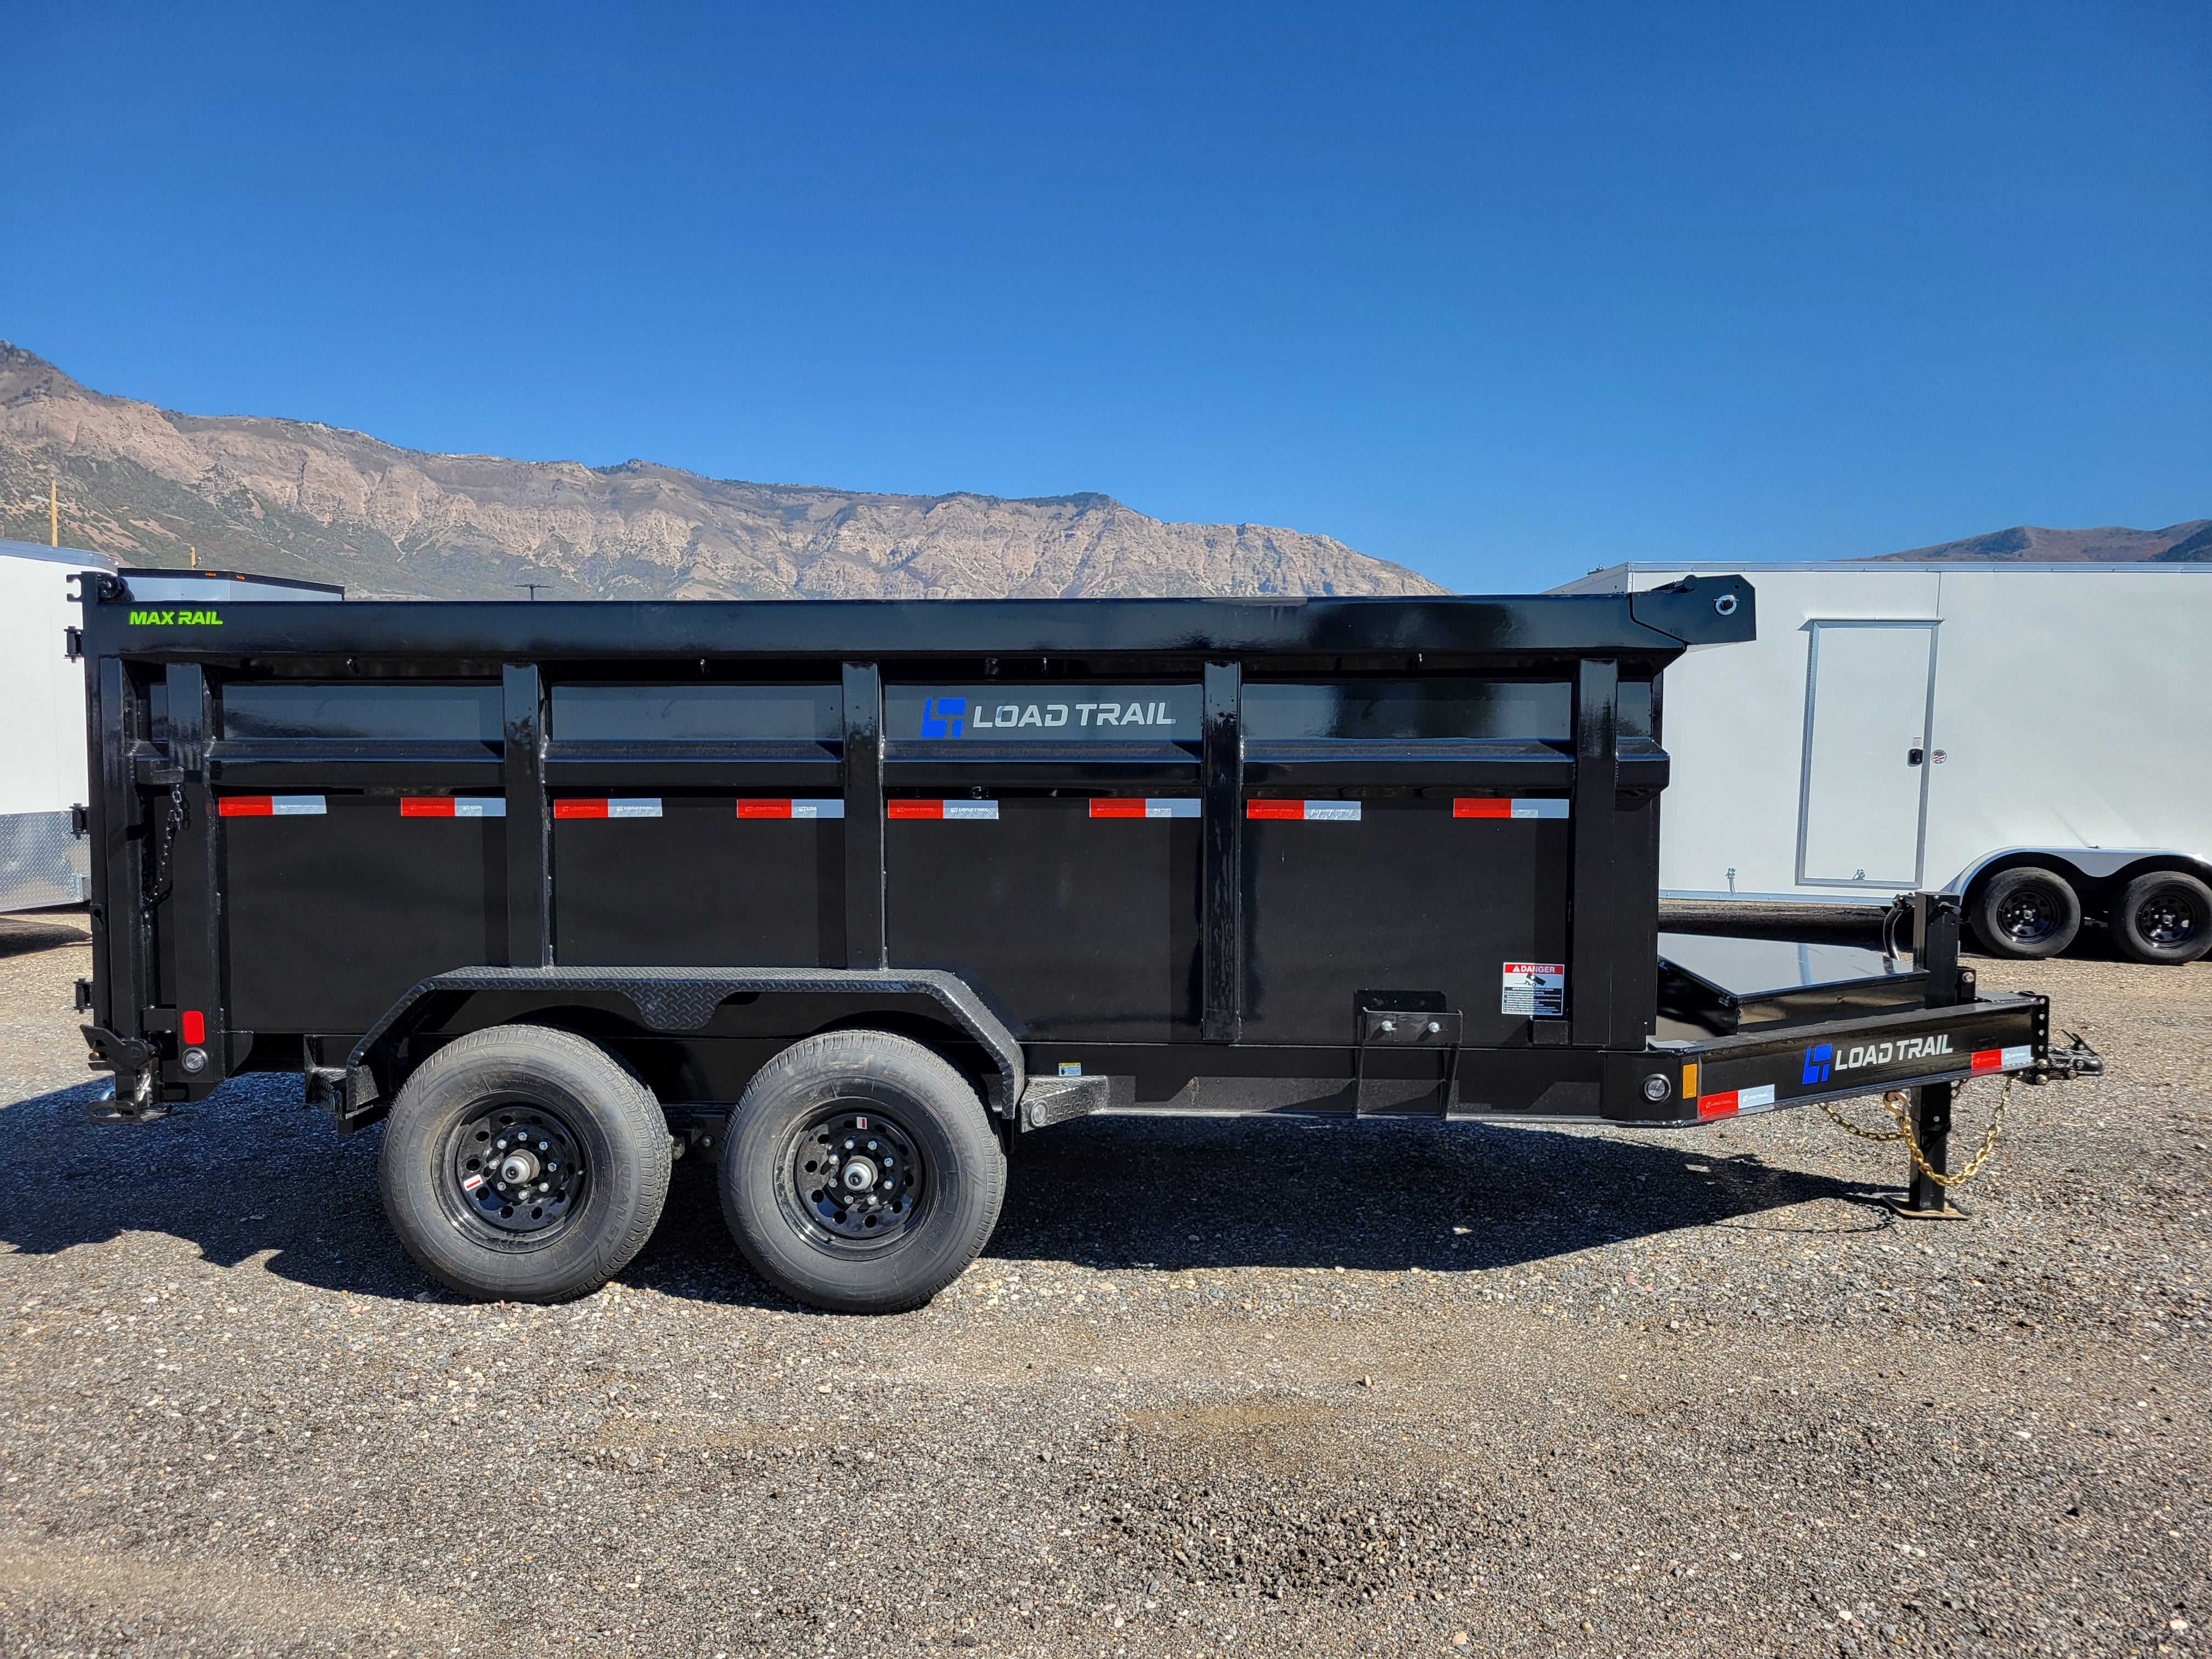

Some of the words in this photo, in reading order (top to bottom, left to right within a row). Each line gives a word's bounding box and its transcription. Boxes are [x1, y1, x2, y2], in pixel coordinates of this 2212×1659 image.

[129, 611, 174, 625] MAX
[178, 611, 223, 625] RAIL
[973, 704, 1069, 728] LOAD
[1075, 702, 1177, 726] TRAIL
[1835, 1042, 1893, 1071] LOAD
[1896, 1034, 1953, 1061] TRAIL
